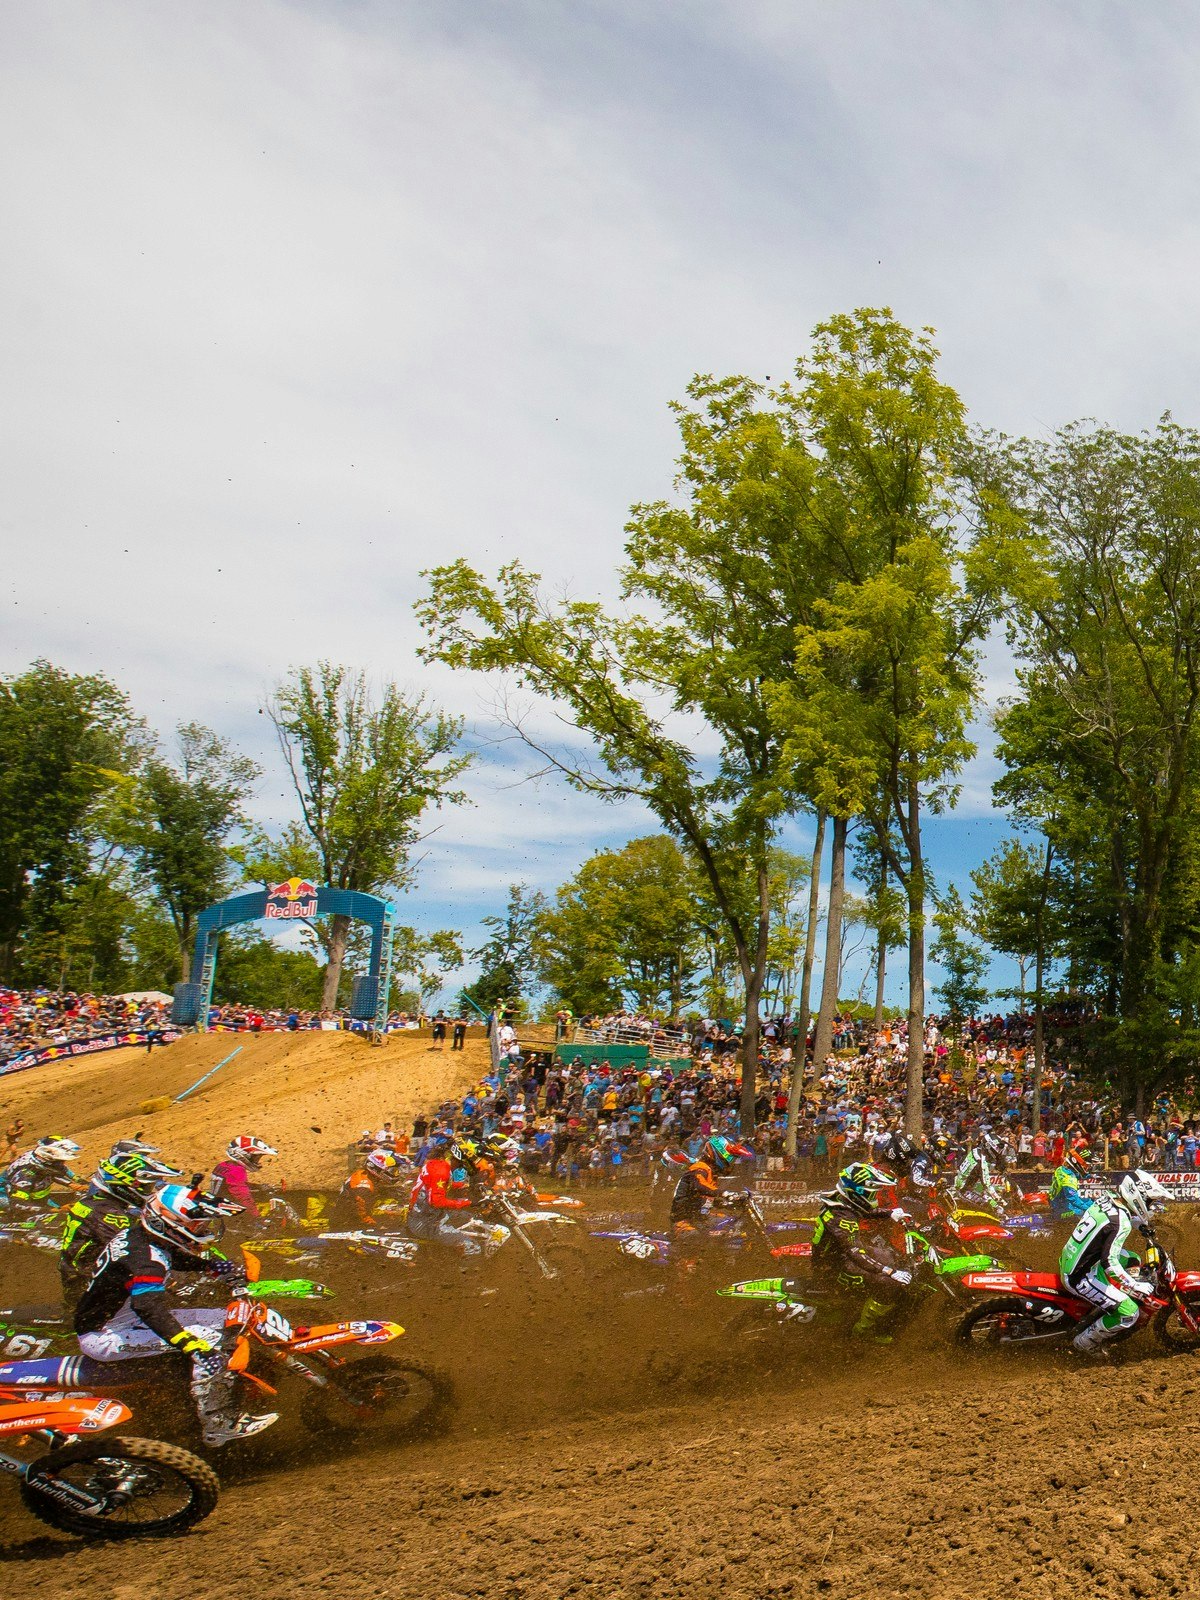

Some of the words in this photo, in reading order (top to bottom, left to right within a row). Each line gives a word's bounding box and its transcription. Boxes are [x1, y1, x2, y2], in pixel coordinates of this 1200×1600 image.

[1183, 1172, 1199, 1183] OIL
[1033, 1306, 1065, 1323] 23
[5, 1334, 53, 1359] 61
